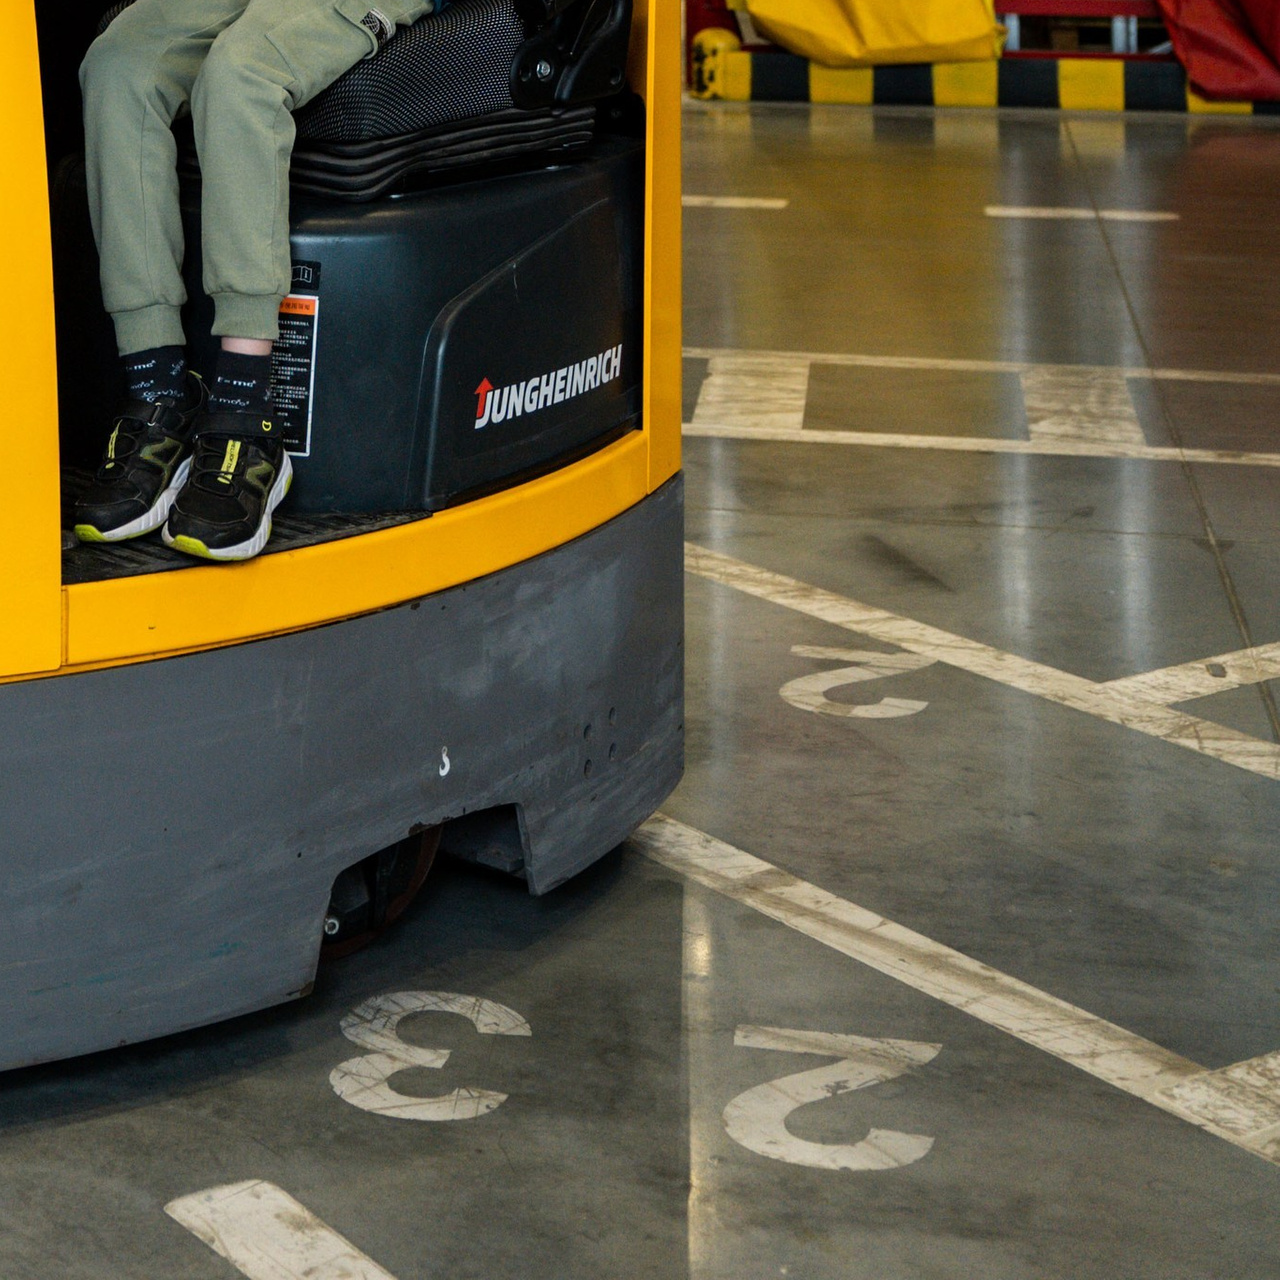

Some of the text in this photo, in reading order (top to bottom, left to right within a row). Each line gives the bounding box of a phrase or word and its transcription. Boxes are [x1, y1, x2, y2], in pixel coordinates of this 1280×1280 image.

[474, 344, 623, 430] JUNGHEINRICH
[330, 990, 943, 1171] 2 3
